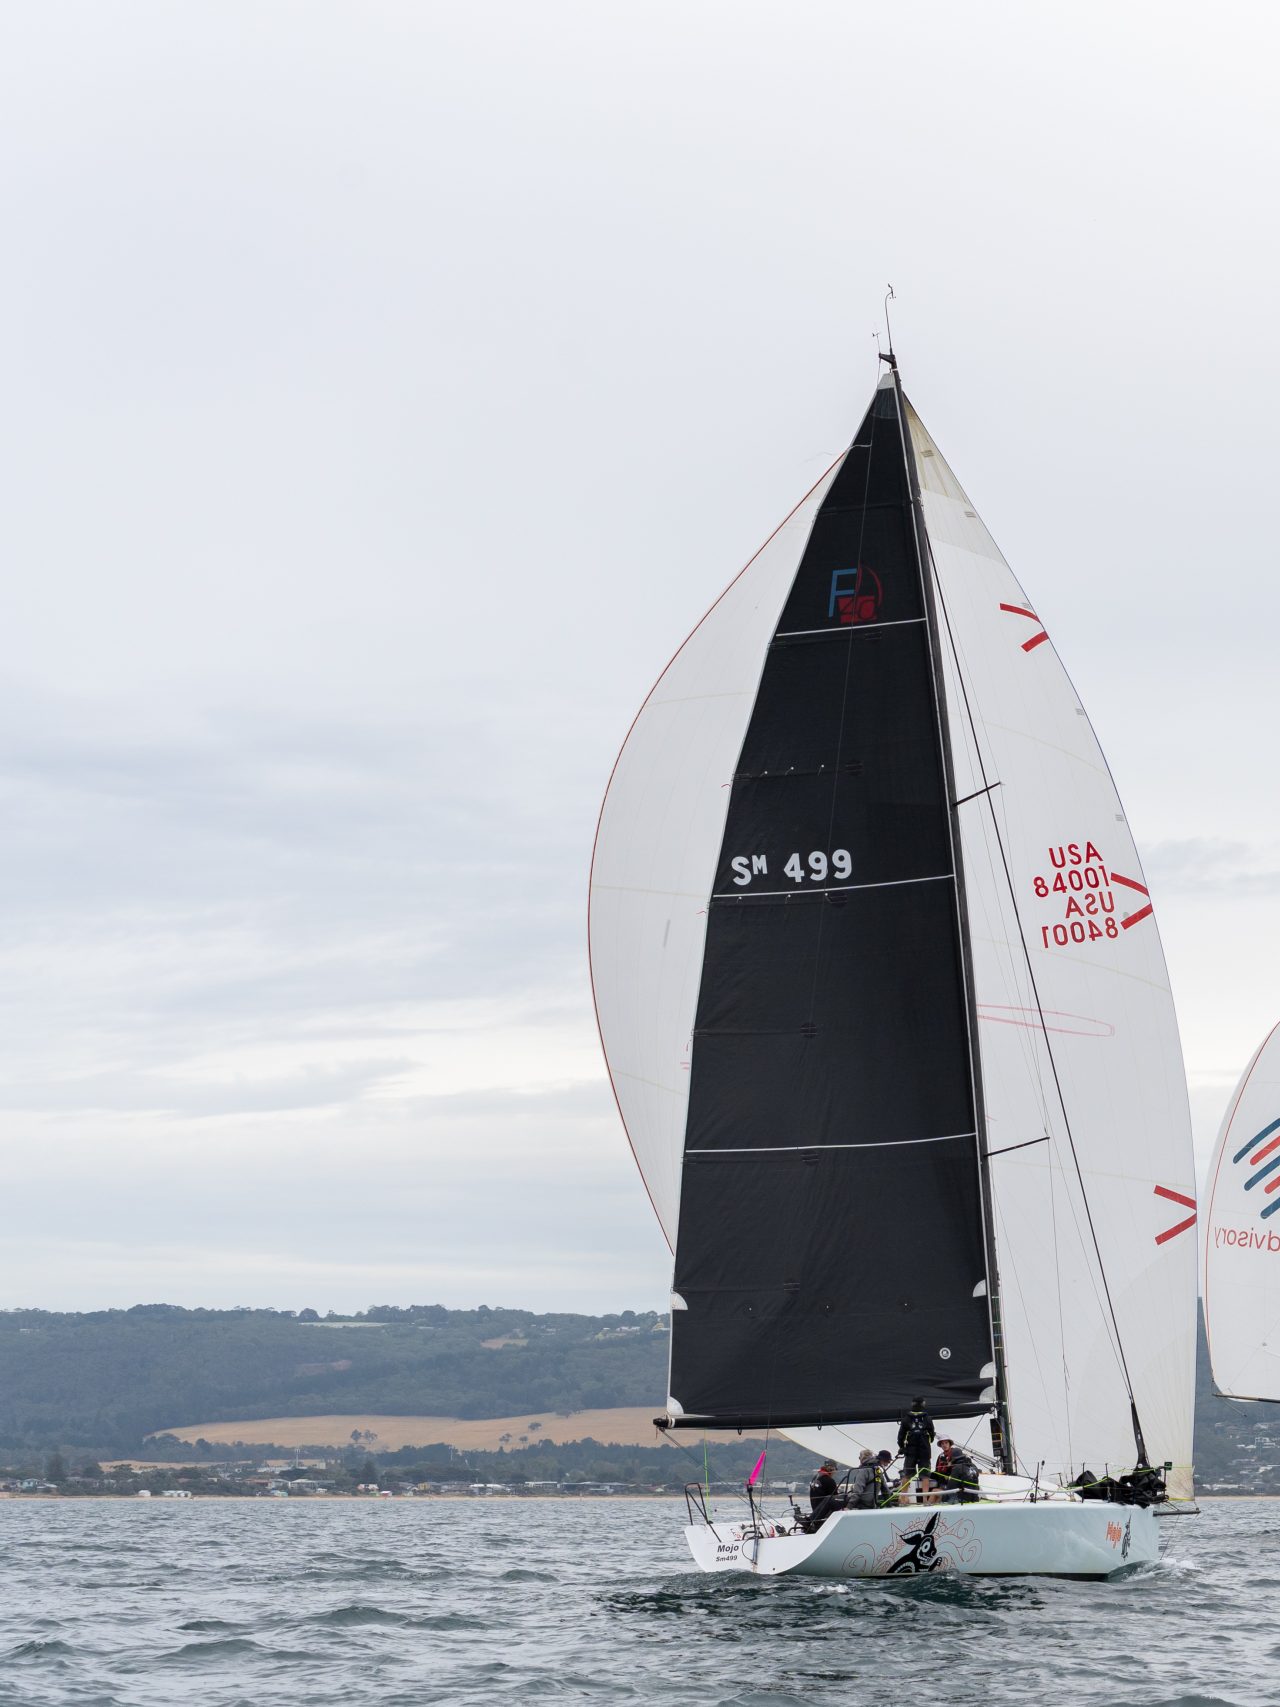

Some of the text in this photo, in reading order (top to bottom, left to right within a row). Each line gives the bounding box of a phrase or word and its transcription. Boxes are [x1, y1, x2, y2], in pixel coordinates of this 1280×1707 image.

[783, 848, 853, 883] 499
[1048, 841, 1104, 869] USA
[1032, 865, 1110, 898] 84001
[717, 1544, 739, 1553] Mojo
